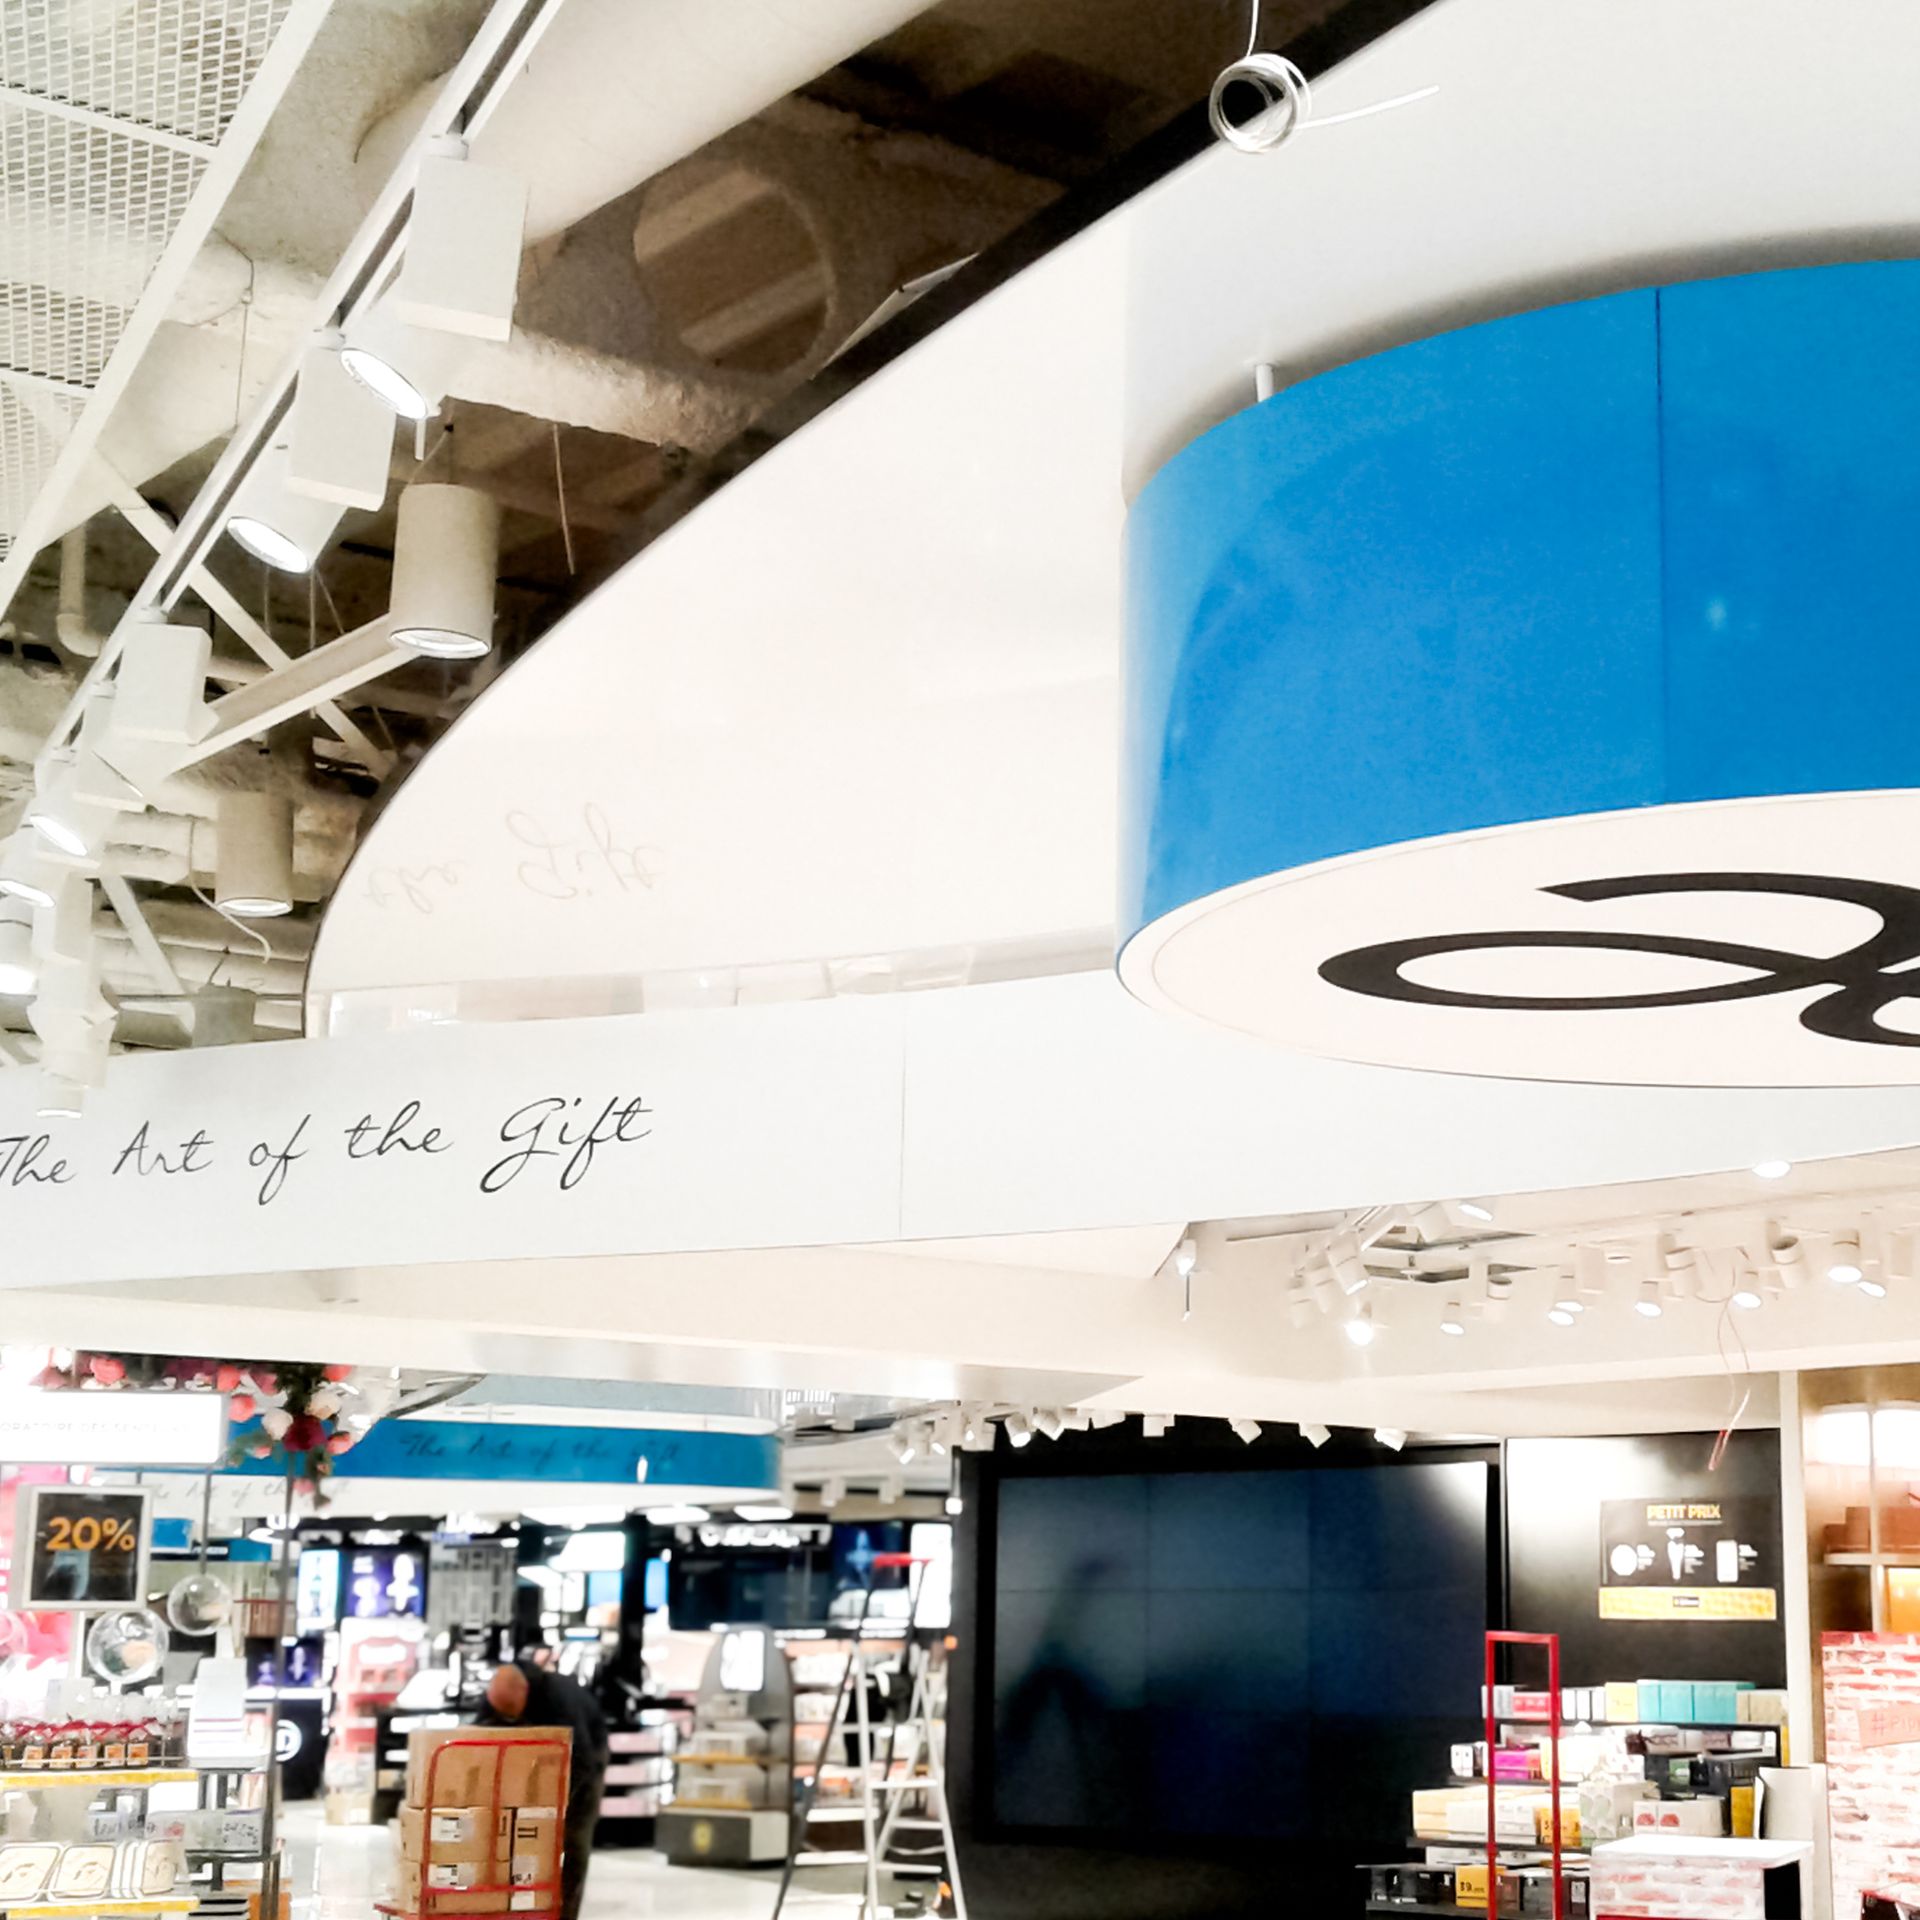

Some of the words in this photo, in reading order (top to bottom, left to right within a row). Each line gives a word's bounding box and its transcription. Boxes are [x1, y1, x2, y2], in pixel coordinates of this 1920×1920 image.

[0, 1135, 75, 1186] The
[112, 1120, 214, 1177] Art
[248, 1113, 312, 1206] of
[344, 1100, 454, 1160] the
[479, 1096, 654, 1194] Gift
[1647, 1505, 1686, 1519] PETIT
[1688, 1504, 1722, 1519] PRIX
[45, 1516, 136, 1551] 20%
